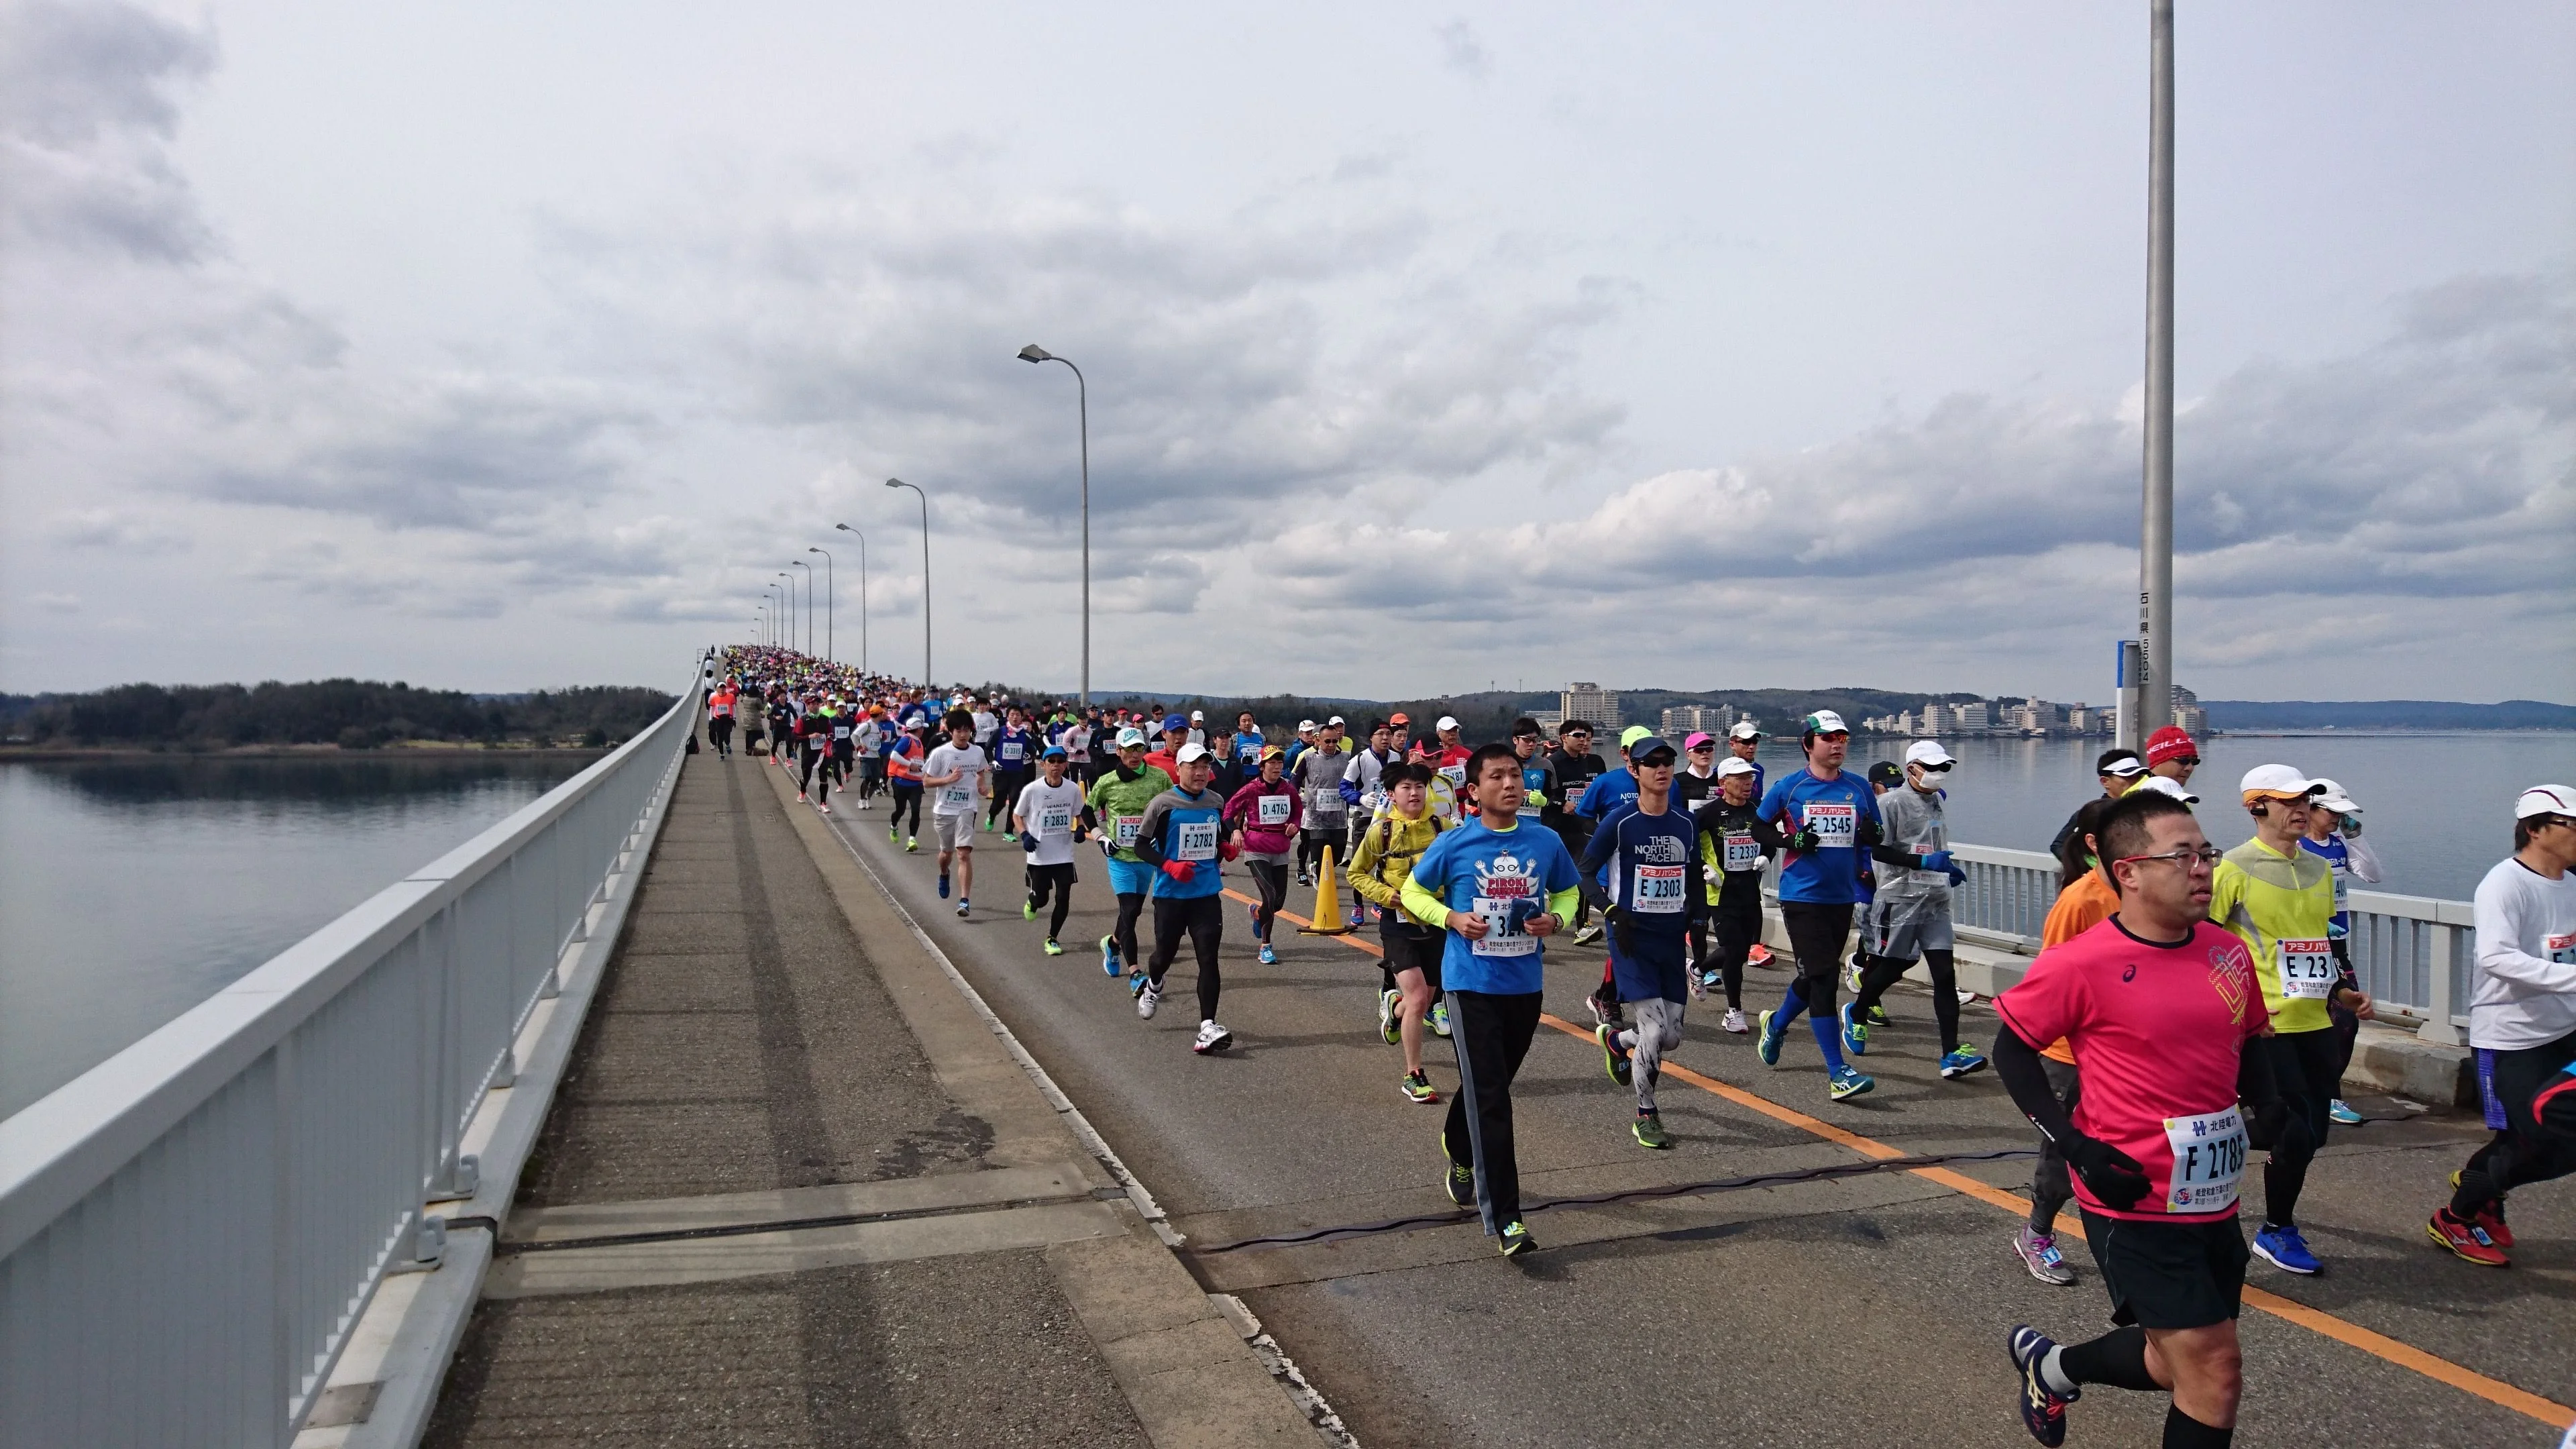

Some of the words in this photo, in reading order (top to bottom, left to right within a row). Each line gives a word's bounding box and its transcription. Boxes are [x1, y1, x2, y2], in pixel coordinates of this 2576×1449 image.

[2140, 592, 2149, 633] 石川県
[1124, 729, 1138, 738] RUN
[947, 791, 952, 799] F
[953, 792, 969, 802] 2744
[1263, 804, 1268, 815] D
[1271, 803, 1289, 815] 4762
[1044, 816, 1049, 827] F
[1052, 814, 1068, 826] 2832
[1810, 816, 1817, 833] E
[1823, 816, 1851, 833] 2545
[1121, 825, 1126, 837] E
[1185, 834, 1190, 848] F
[1193, 833, 1213, 848] 2782
[1650, 836, 1670, 845] THE
[1635, 845, 1670, 854] NORTH
[1729, 846, 1735, 860] E
[1739, 845, 1758, 859] 2339
[1646, 853, 1670, 863] FACE
[1643, 868, 1680, 877] アミノバリュー
[1488, 878, 1527, 887] PIROKI
[1641, 879, 1648, 896] E
[1654, 879, 1680, 898] 2303
[2287, 942, 2331, 951] アミノバリ
[2286, 956, 2299, 977] E
[2210, 1115, 2237, 1132] 北陸電力
[2186, 1146, 2198, 1181] F
[2208, 1134, 2243, 1179] 2785
